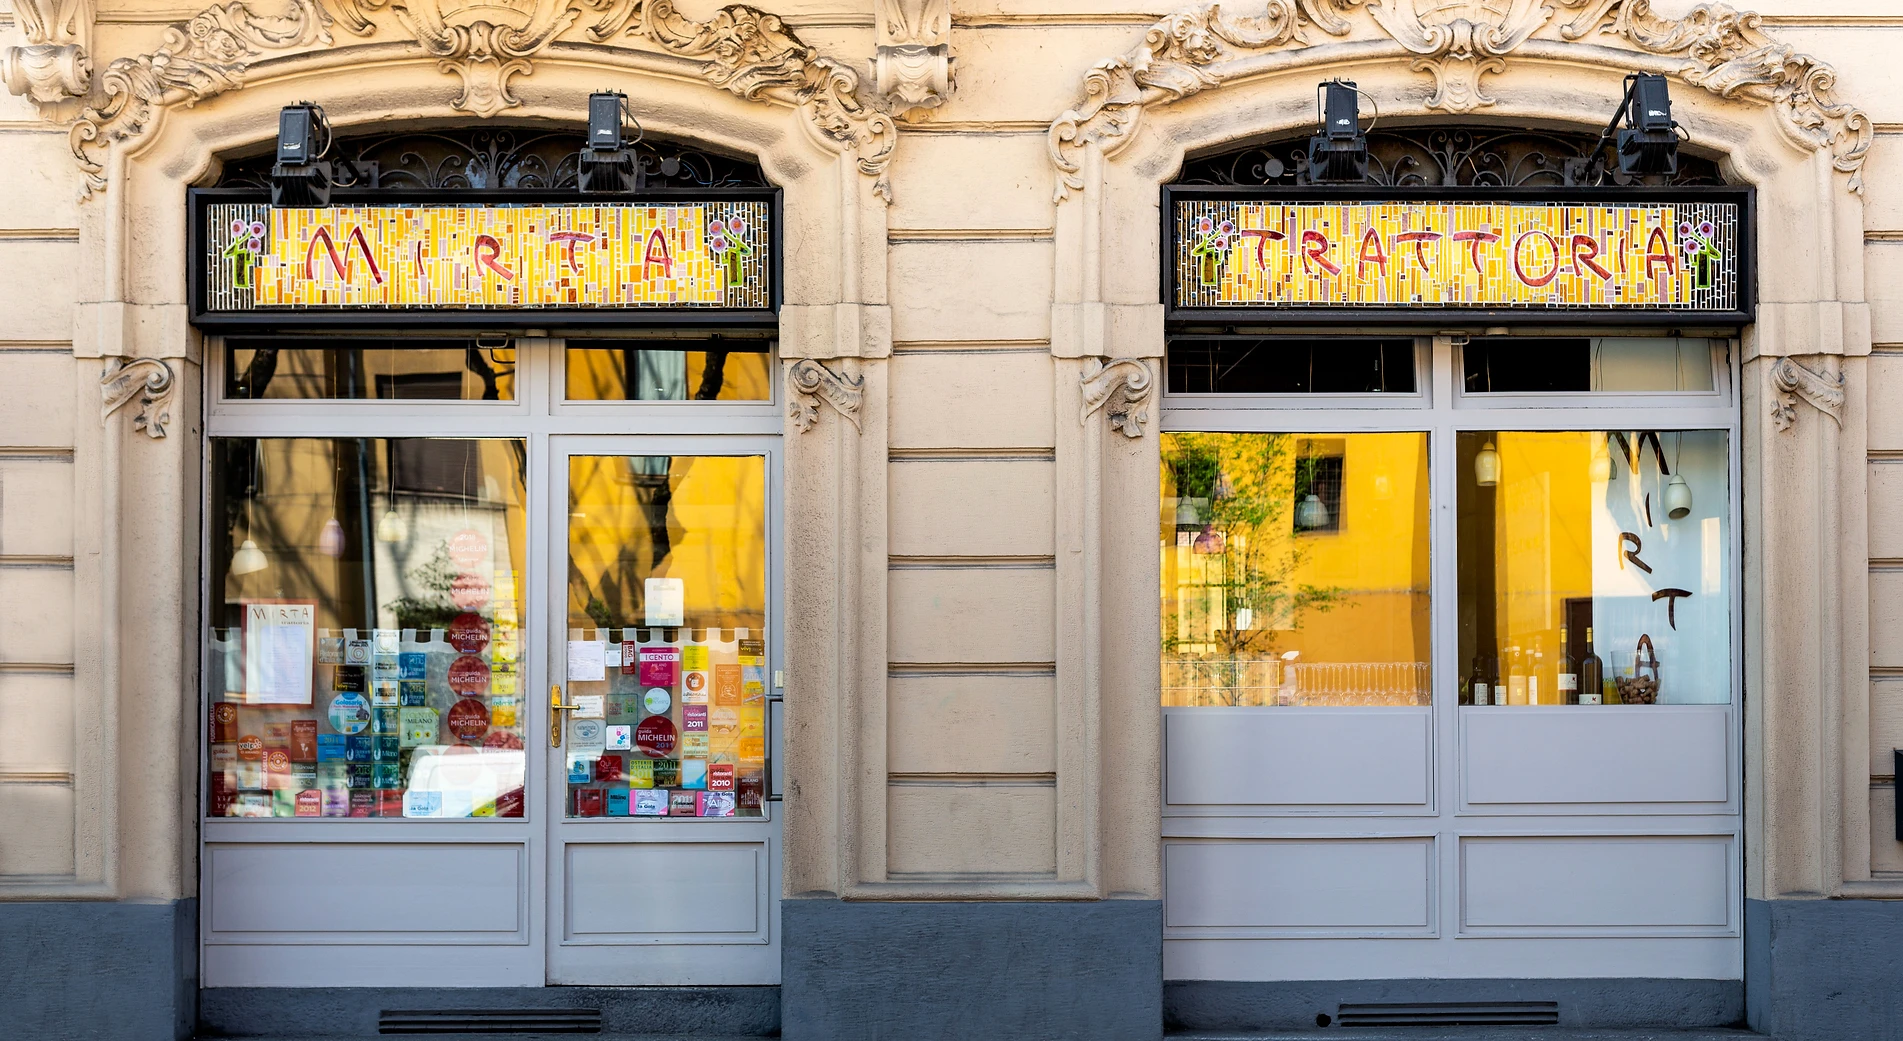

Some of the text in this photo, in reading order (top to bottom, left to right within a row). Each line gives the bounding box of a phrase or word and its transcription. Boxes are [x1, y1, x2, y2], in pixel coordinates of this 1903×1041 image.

[305, 225, 673, 284] MIRTA
[1240, 226, 1676, 288] TRATTORIA
[449, 544, 487, 552] MICHELIN
[1603, 430, 1693, 681] MIRTA
[451, 587, 490, 595] MICHELIN
[251, 607, 309, 620] MIRTA
[451, 633, 488, 641] MICHELIN
[637, 734, 675, 742] MICHELIN
